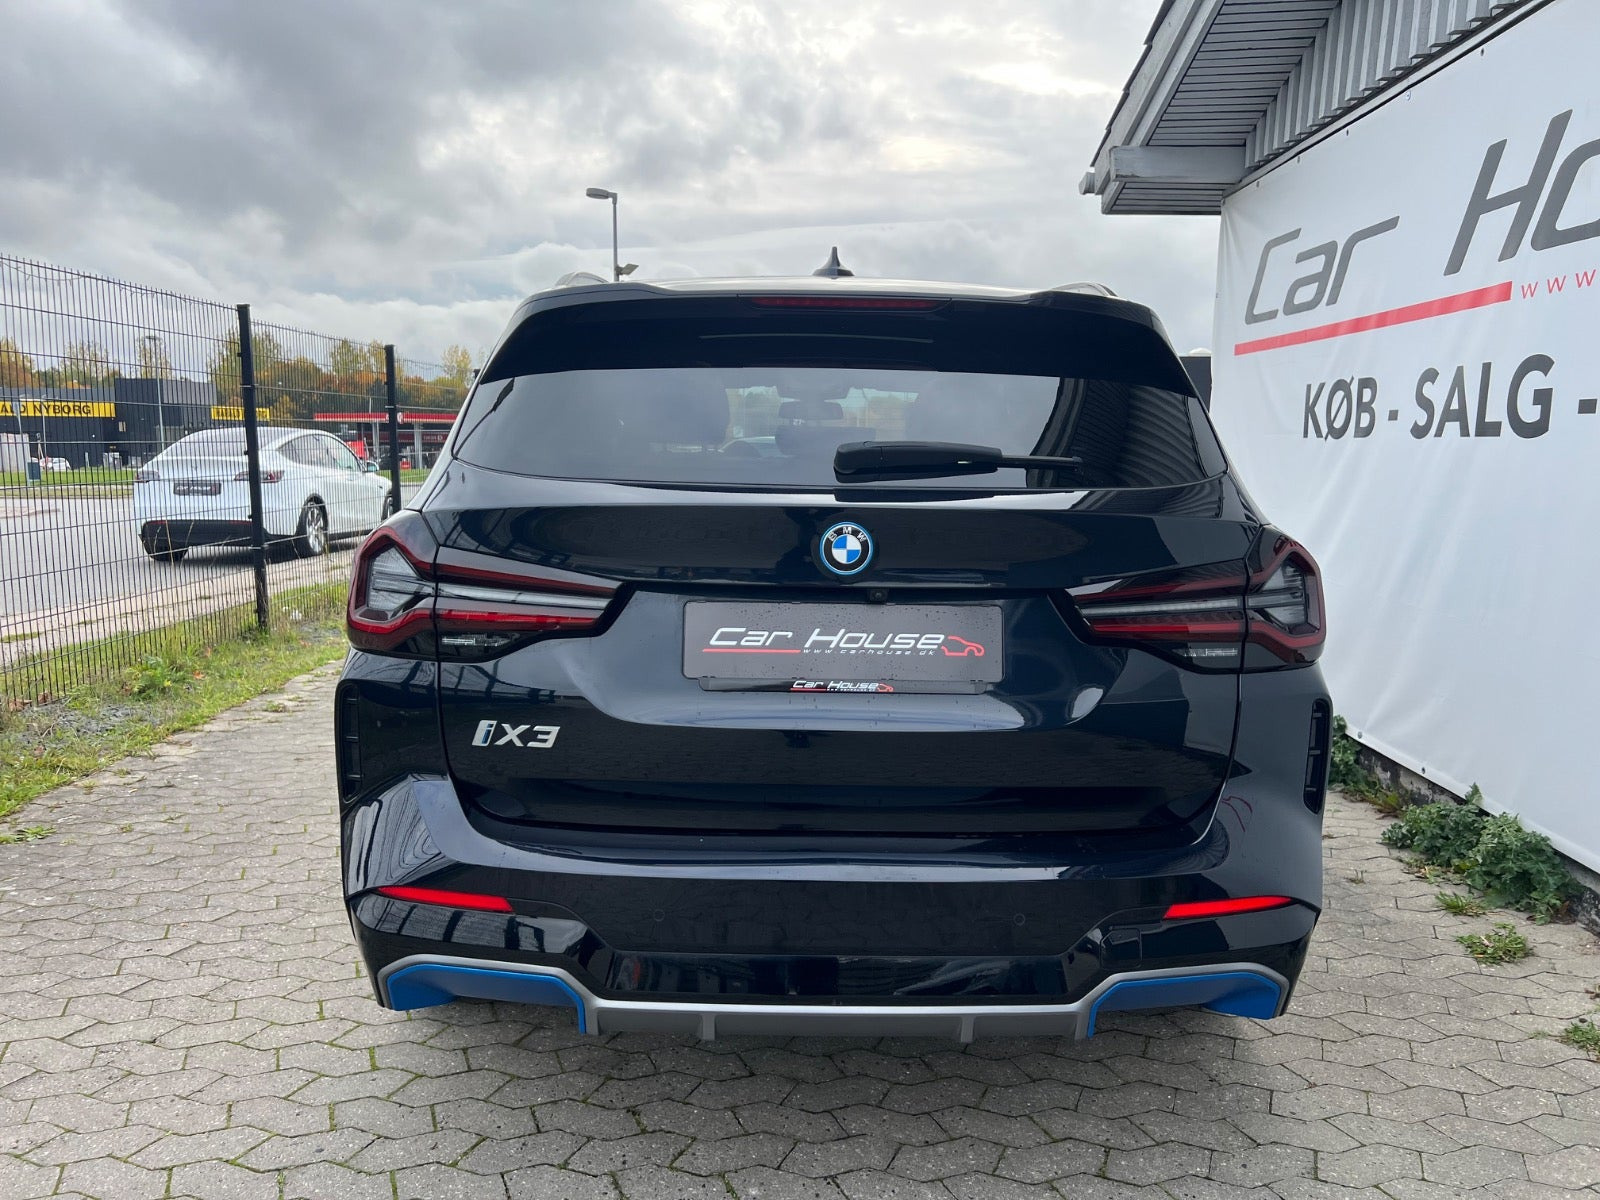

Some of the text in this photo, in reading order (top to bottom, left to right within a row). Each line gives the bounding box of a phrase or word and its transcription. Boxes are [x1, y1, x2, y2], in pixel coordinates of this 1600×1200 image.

[1245, 215, 1400, 325] Car
[1303, 376, 1378, 441] KØB
[1410, 354, 1555, 439] SALG
[33, 404, 92, 415] NYBORG
[828, 526, 867, 542] BMW
[709, 627, 945, 649] Car House
[792, 680, 878, 689] Car House
[471, 719, 561, 749] iX3
